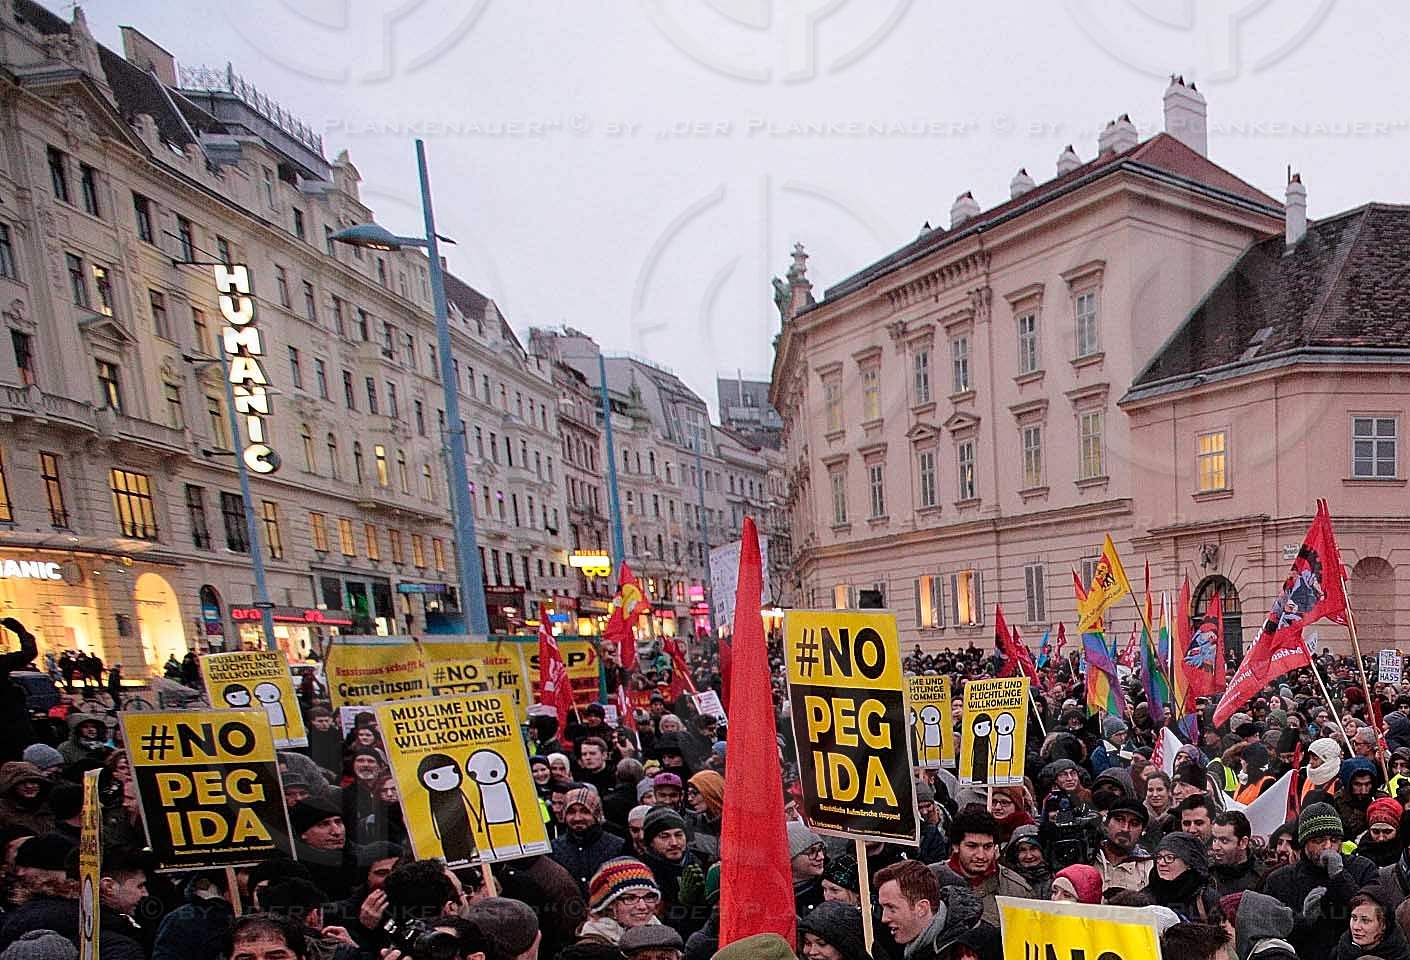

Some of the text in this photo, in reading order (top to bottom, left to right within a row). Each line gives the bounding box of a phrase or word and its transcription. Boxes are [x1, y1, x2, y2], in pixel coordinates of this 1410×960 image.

[213, 264, 278, 473] HUMANIC
[254, 652, 279, 663] UND
[530, 652, 586, 671] SP
[795, 626, 887, 680] #NO
[432, 664, 479, 684] #NO
[497, 671, 519, 688] für
[925, 677, 944, 687] UND
[1379, 673, 1400, 683] HASS
[338, 679, 424, 698] Gemeinsam
[969, 689, 1022, 701] FLÜCHTLINGE
[970, 680, 1023, 692] MUSLIME UND
[391, 698, 502, 722] MUSLIME UND
[967, 698, 1023, 710] WILLKOMMEN!
[394, 711, 506, 736] FLÜCHTLINGE
[804, 695, 893, 750] PEG
[141, 720, 257, 761] #NO
[394, 725, 513, 750] WILLKOMMEN!
[155, 768, 266, 807] PEG
[812, 750, 899, 807] IDA
[166, 807, 273, 847] IDA
